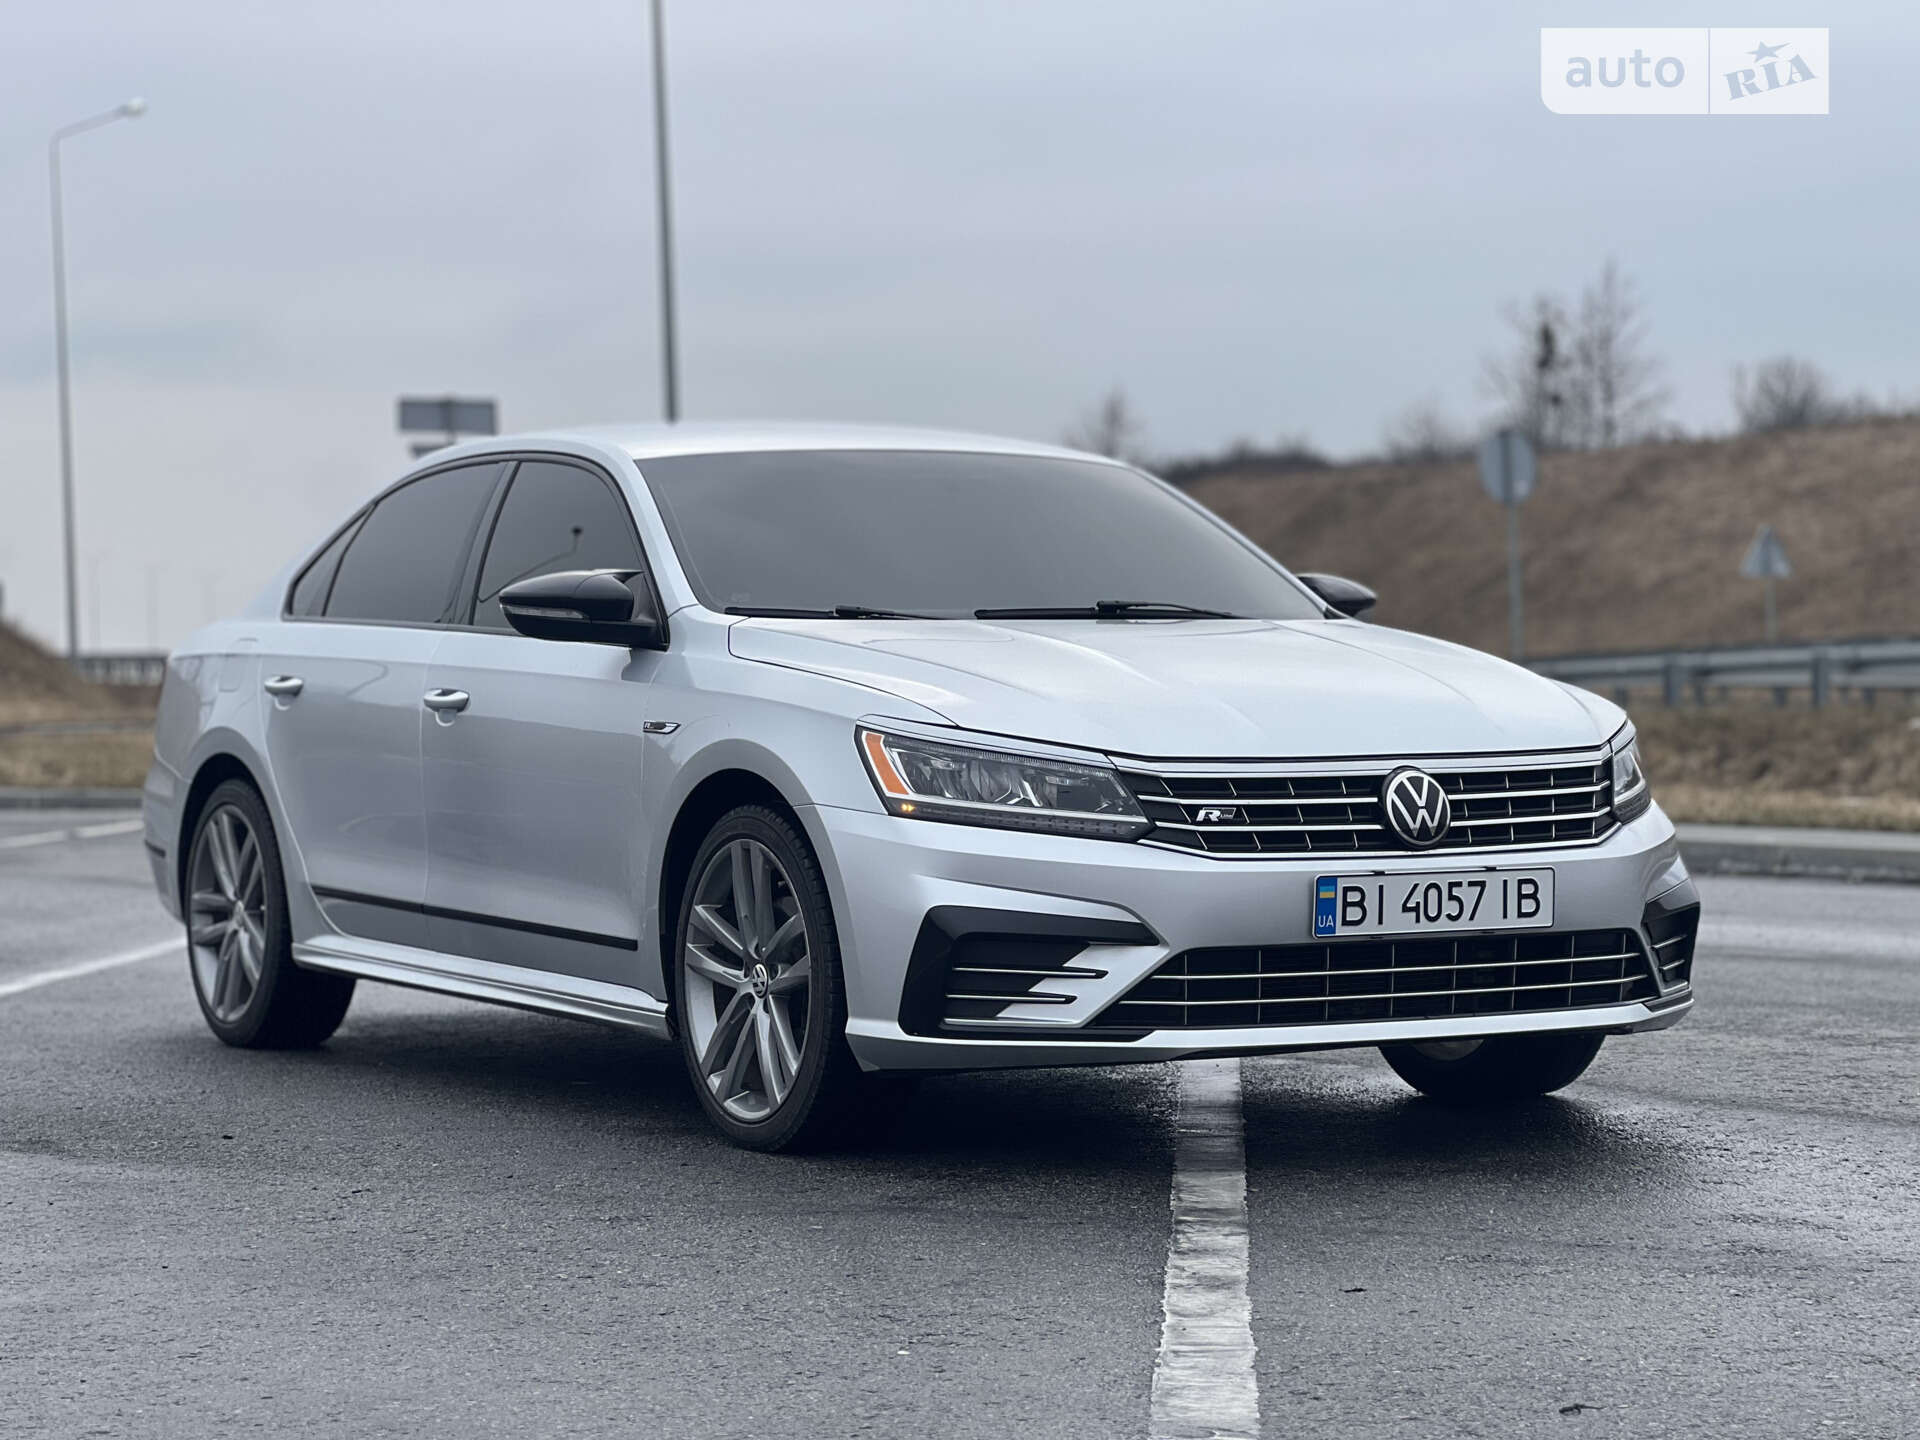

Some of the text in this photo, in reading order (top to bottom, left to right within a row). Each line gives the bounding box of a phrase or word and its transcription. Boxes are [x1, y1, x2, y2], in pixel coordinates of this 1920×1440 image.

[1341, 877, 1541, 927] BI 4057 IB
[1318, 914, 1334, 928] UA
